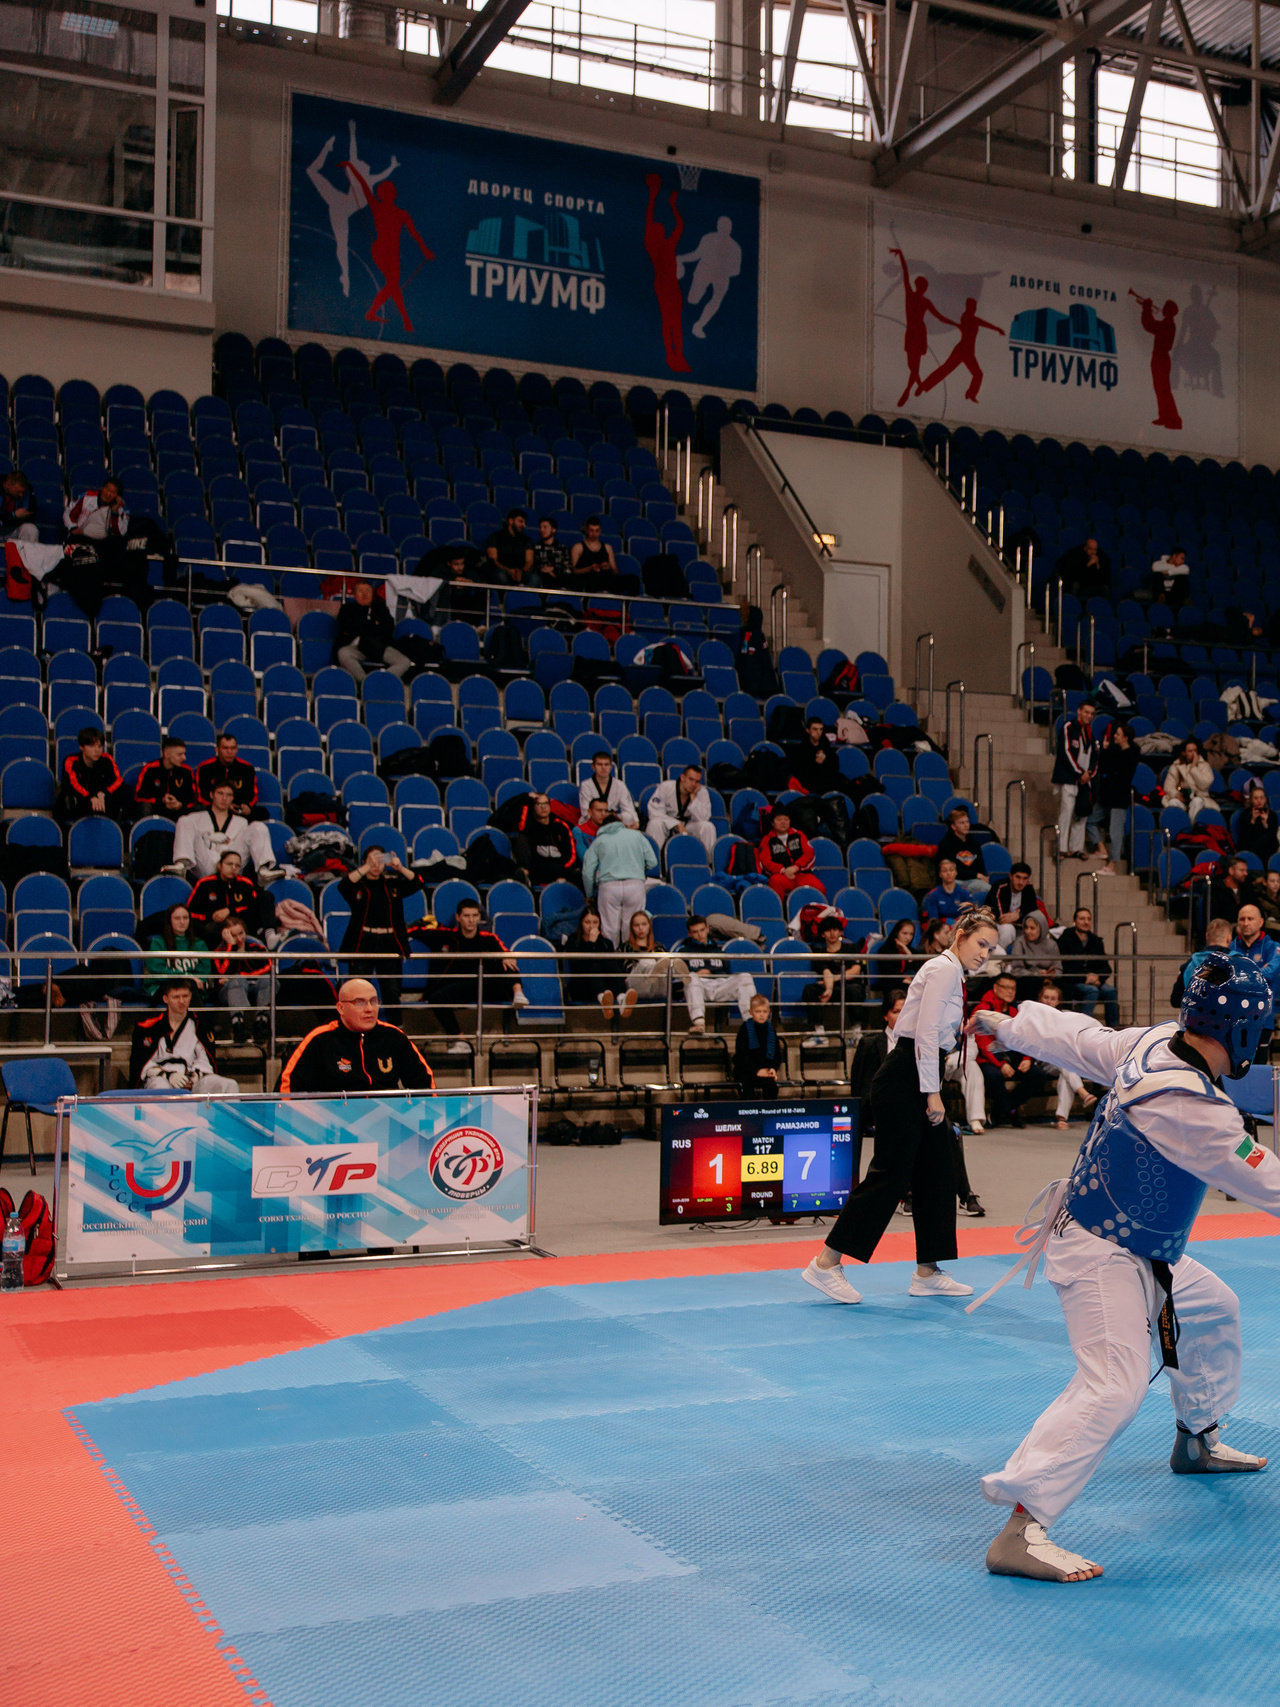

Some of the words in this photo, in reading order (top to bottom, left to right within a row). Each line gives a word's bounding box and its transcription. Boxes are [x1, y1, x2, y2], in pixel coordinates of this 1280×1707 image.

[468, 179, 533, 203] ДВОРЕЦ
[544, 192, 605, 214] СПОРТА
[465, 257, 606, 314] ТРИУМФ
[1010, 274, 1061, 295] ДВОРЕЦ
[1069, 284, 1117, 302] СПОРТА
[1009, 346, 1119, 391] ТРИУМФ
[715, 1124, 742, 1132] ШЕЛИХ
[776, 1121, 819, 1130] РАМАЗАНОВ
[832, 1134, 851, 1142] RUS
[672, 1139, 691, 1148] RUS
[755, 1145, 771, 1154] 117
[709, 1153, 723, 1184] 1
[747, 1161, 778, 1174] 6.89
[798, 1150, 816, 1180] 7
[759, 1199, 764, 1208] 1
[792, 1200, 797, 1208] 7
[838, 1197, 843, 1205] 1
[677, 1205, 683, 1214] 0
[726, 1203, 732, 1212] 3
[259, 1215, 284, 1223] СОЮЗ
[285, 1212, 335, 1222] ТХЭКДО
